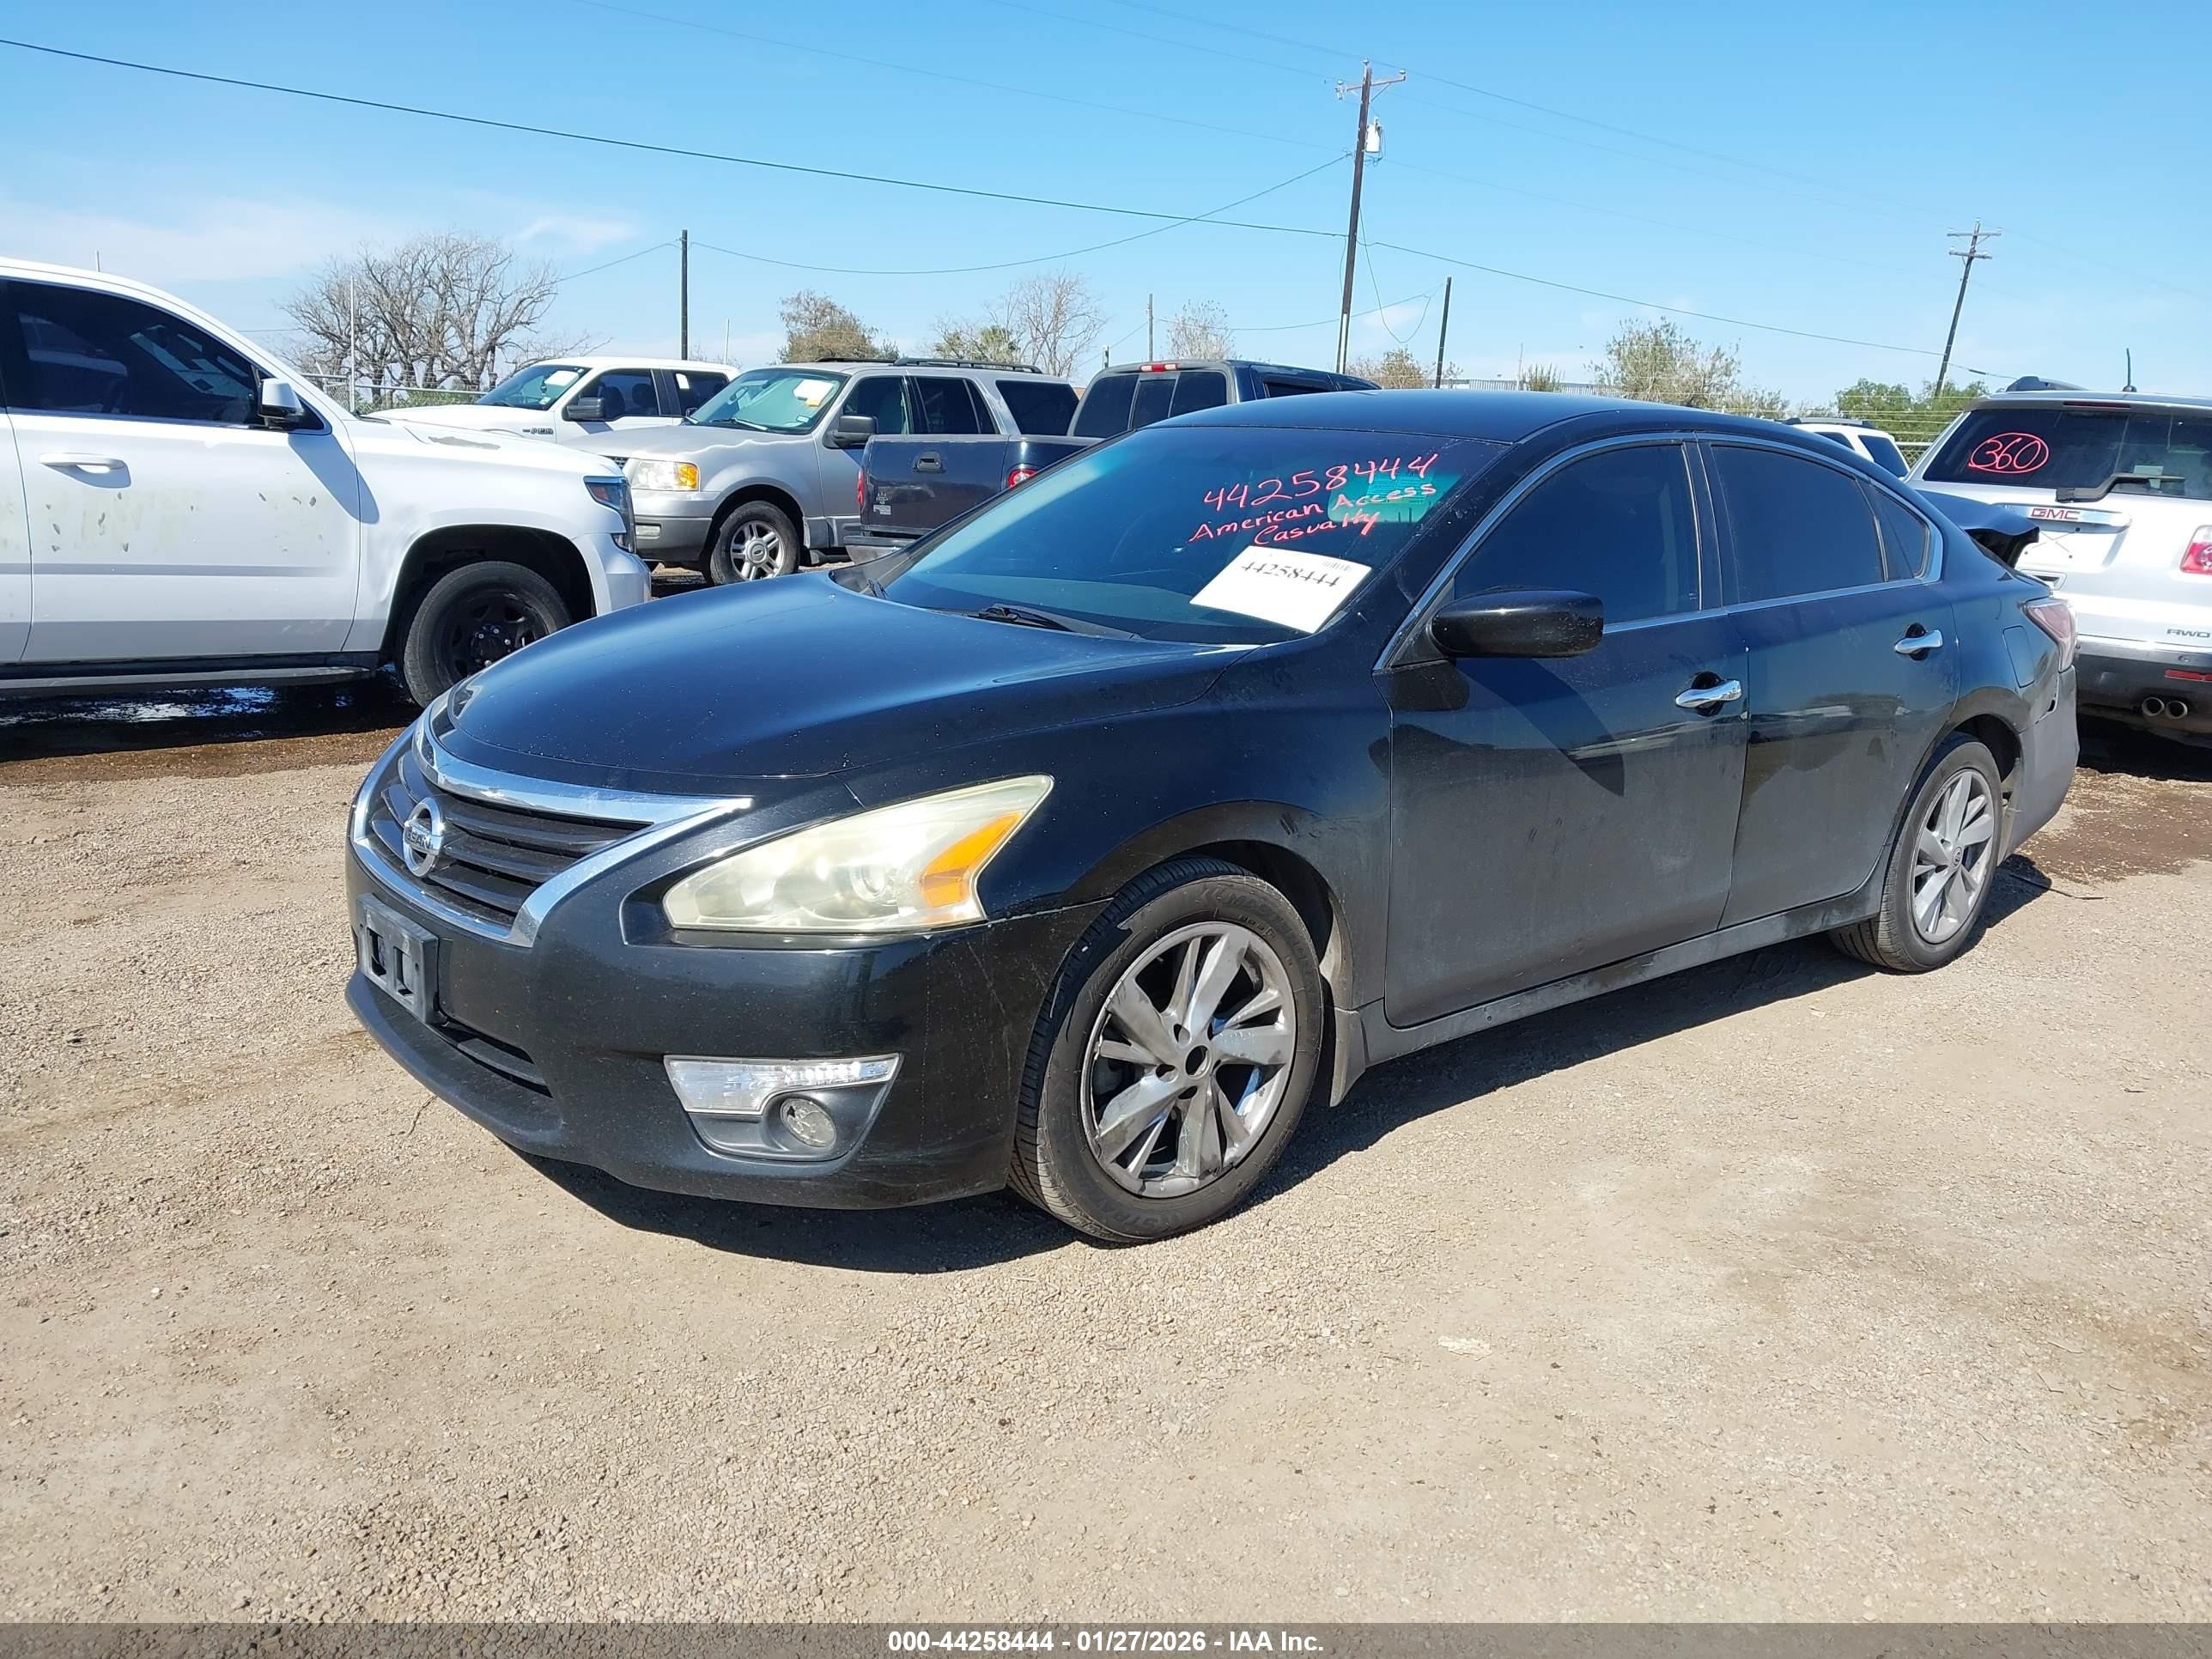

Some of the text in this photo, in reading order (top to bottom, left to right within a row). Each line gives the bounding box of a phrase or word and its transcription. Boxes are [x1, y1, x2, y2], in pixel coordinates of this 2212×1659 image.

[1976, 436, 2042, 470] 360
[1203, 453, 1439, 512] 44258444
[1188, 502, 1324, 542] American
[1332, 483, 1437, 511] Access
[1254, 508, 1380, 545] Casualty
[2031, 507, 2081, 520] GMC
